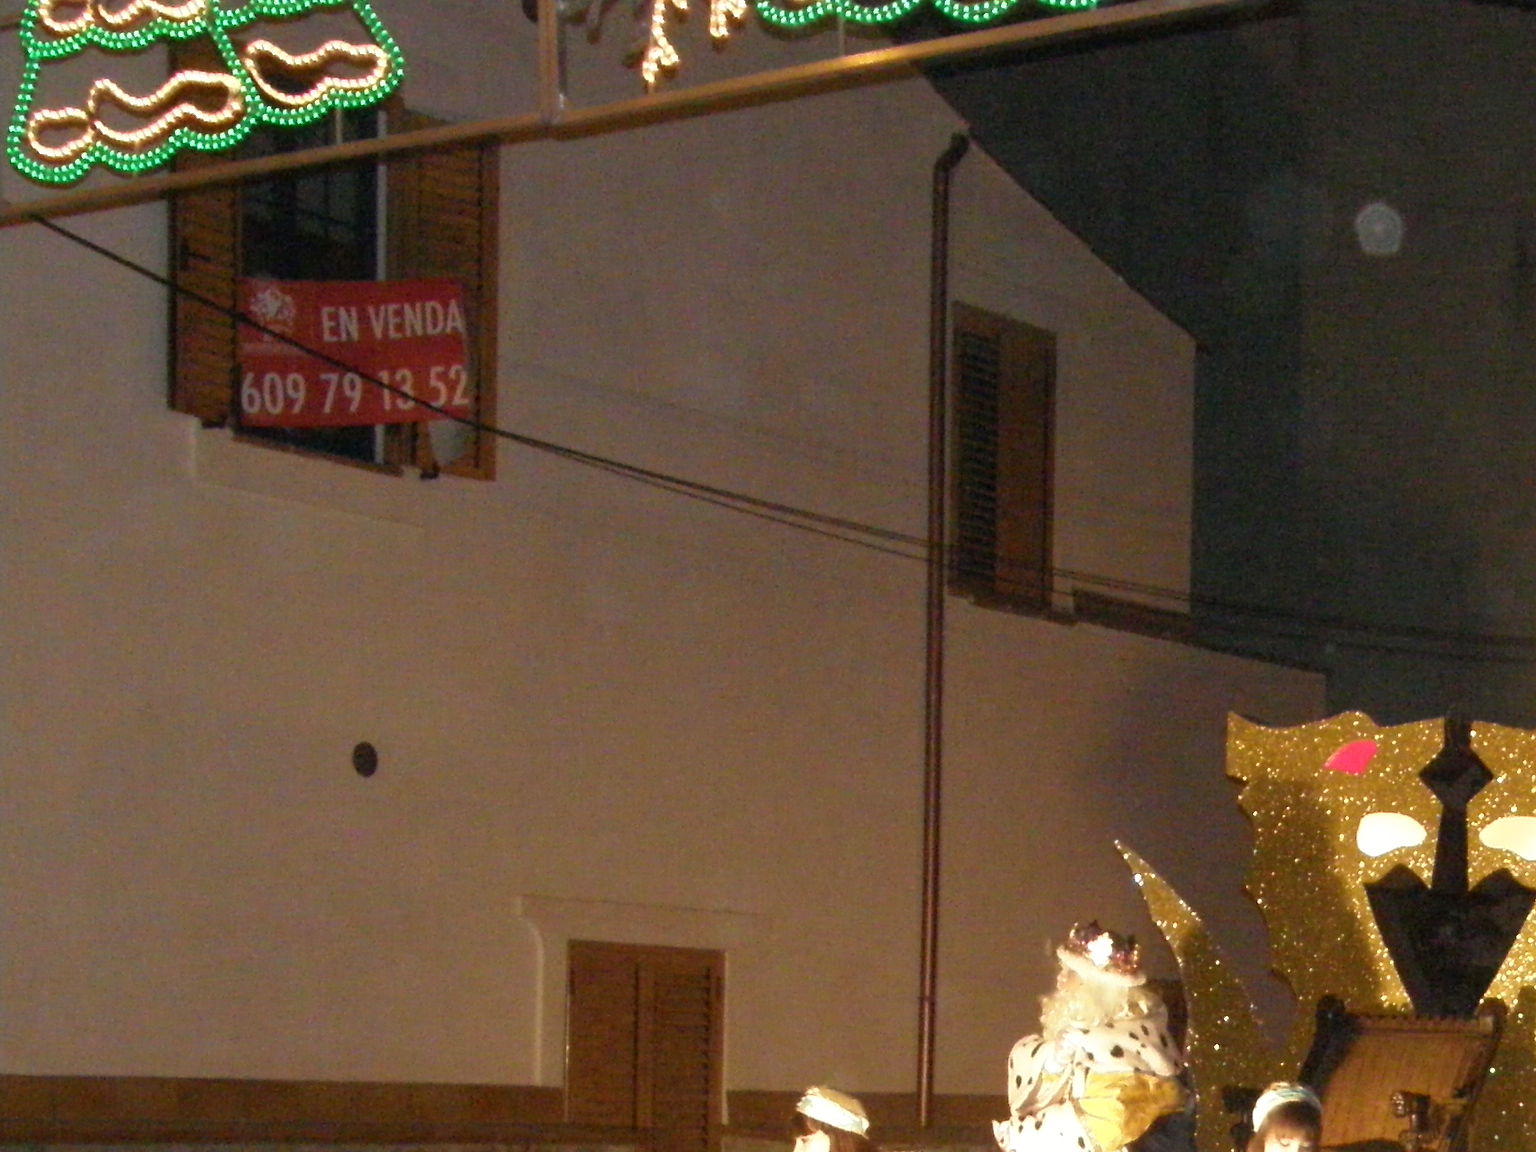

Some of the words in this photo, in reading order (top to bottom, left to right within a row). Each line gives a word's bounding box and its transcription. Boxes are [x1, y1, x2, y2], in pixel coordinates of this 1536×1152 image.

[321, 305, 358, 342] EN
[368, 300, 464, 338] VENDA
[241, 371, 306, 415] 609
[320, 370, 362, 414] 79
[378, 368, 415, 410] 13
[429, 364, 470, 407] 52
